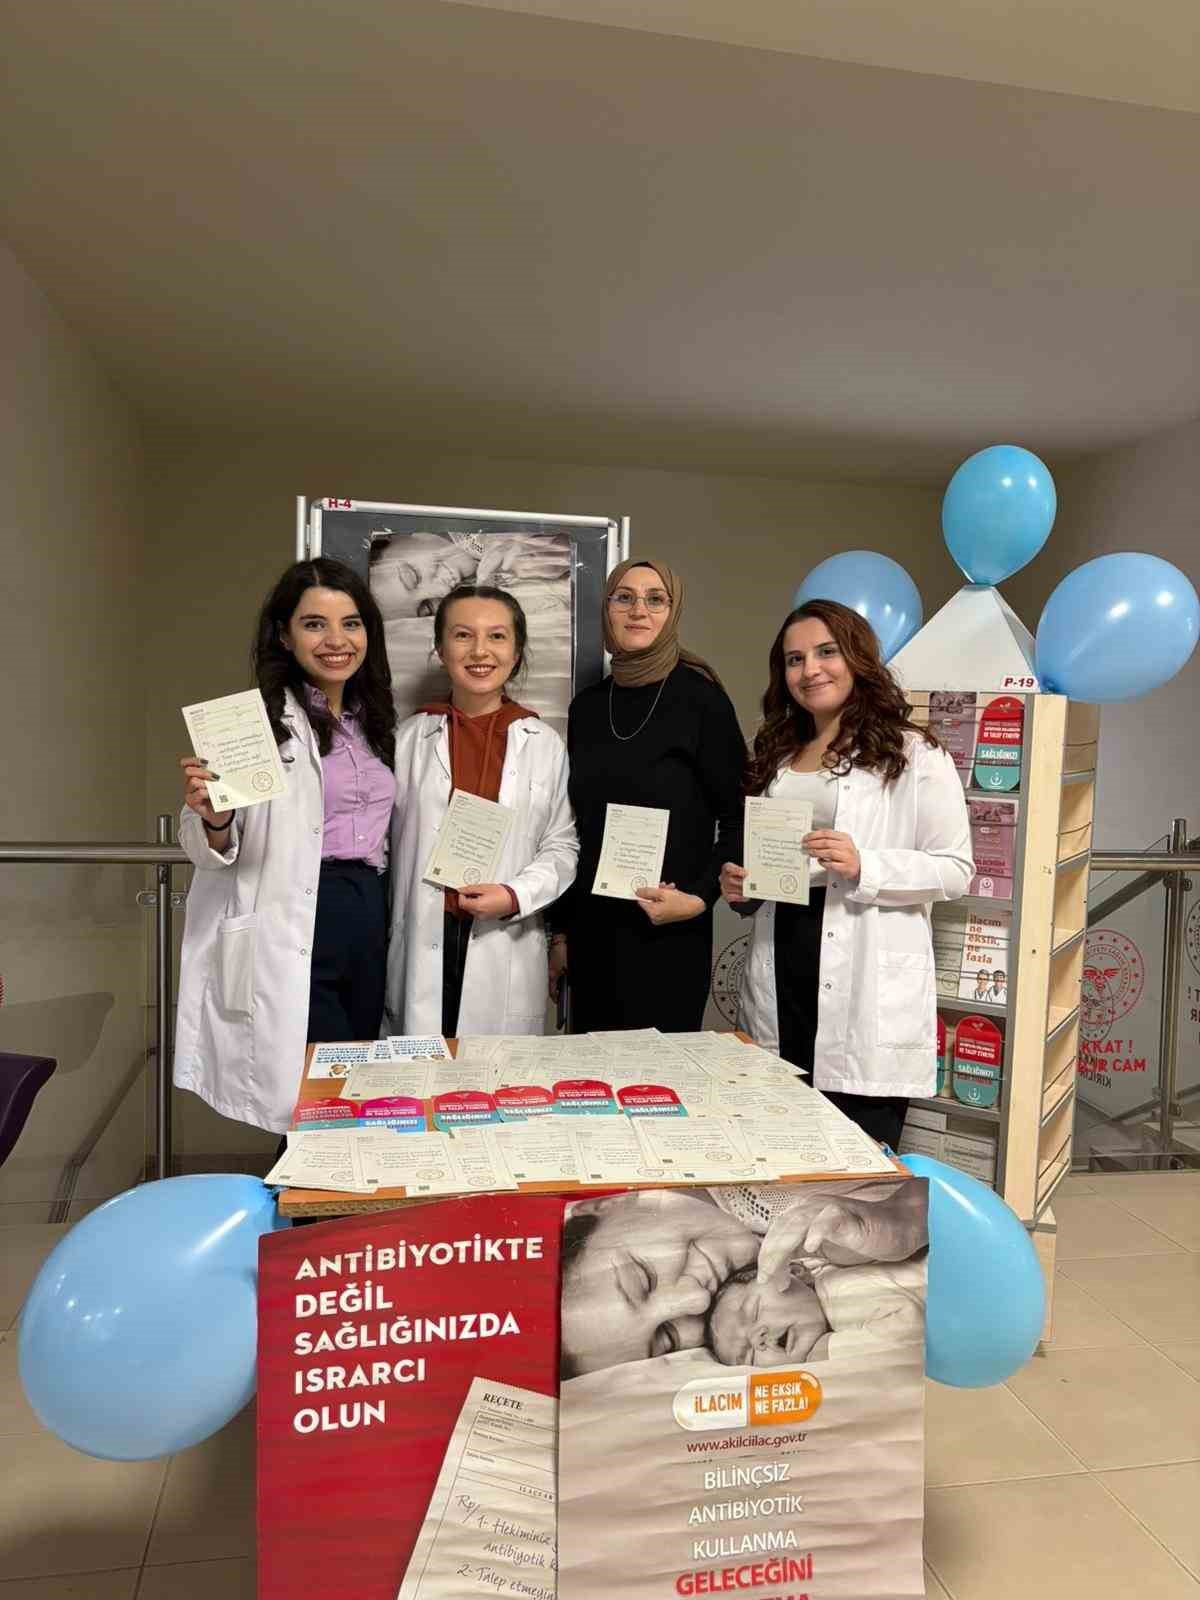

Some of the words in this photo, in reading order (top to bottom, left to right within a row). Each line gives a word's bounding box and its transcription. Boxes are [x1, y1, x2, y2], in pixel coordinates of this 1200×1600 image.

[329, 497, 352, 509] H-4
[1004, 677, 1035, 688] P-19
[1112, 1058, 1147, 1072] CAM
[294, 1233, 543, 1281] ANTİBİYOTİKTE
[295, 1280, 393, 1318] DEĞİL
[293, 1312, 521, 1356] SAĞLIĞINIZDA
[295, 1359, 426, 1395] ISRARCI
[754, 1385, 769, 1398] NE
[293, 1400, 386, 1434] OLUN
[754, 1400, 770, 1415] NE
[772, 1397, 809, 1414] FAZLA!
[686, 1431, 808, 1453] www.akilciilac.gov.tr
[704, 1462, 791, 1490] BİLİNÇSİZ
[688, 1494, 803, 1524] ANTİBİYOTİK
[492, 1518, 551, 1544] Hekiminiz
[693, 1530, 798, 1559] KULLANMA
[483, 1541, 545, 1568] antibiyotik
[476, 1566, 507, 1592] Talep
[675, 1553, 814, 1596] GELECEĞİNİ
